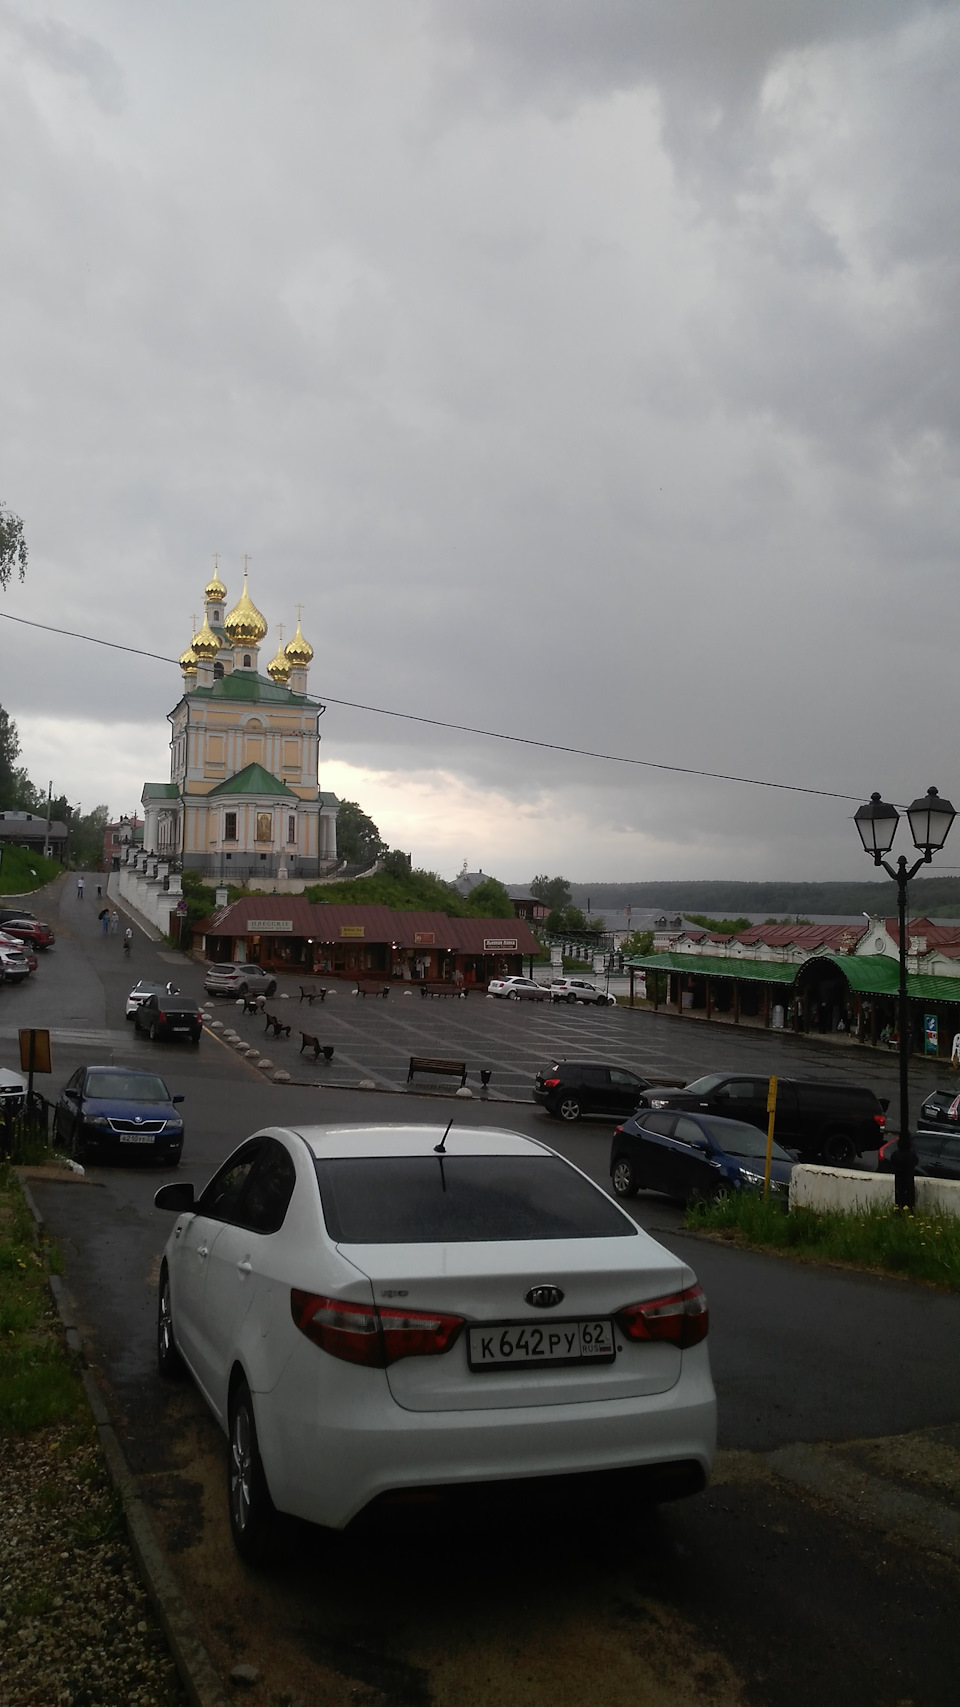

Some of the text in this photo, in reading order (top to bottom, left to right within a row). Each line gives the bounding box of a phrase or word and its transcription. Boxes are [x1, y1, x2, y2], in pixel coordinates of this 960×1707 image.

[532, 1289, 560, 1305] KIA
[582, 1323, 605, 1344] 62
[481, 1328, 575, 1358] К642РУ
[582, 1344, 599, 1353] RUS
